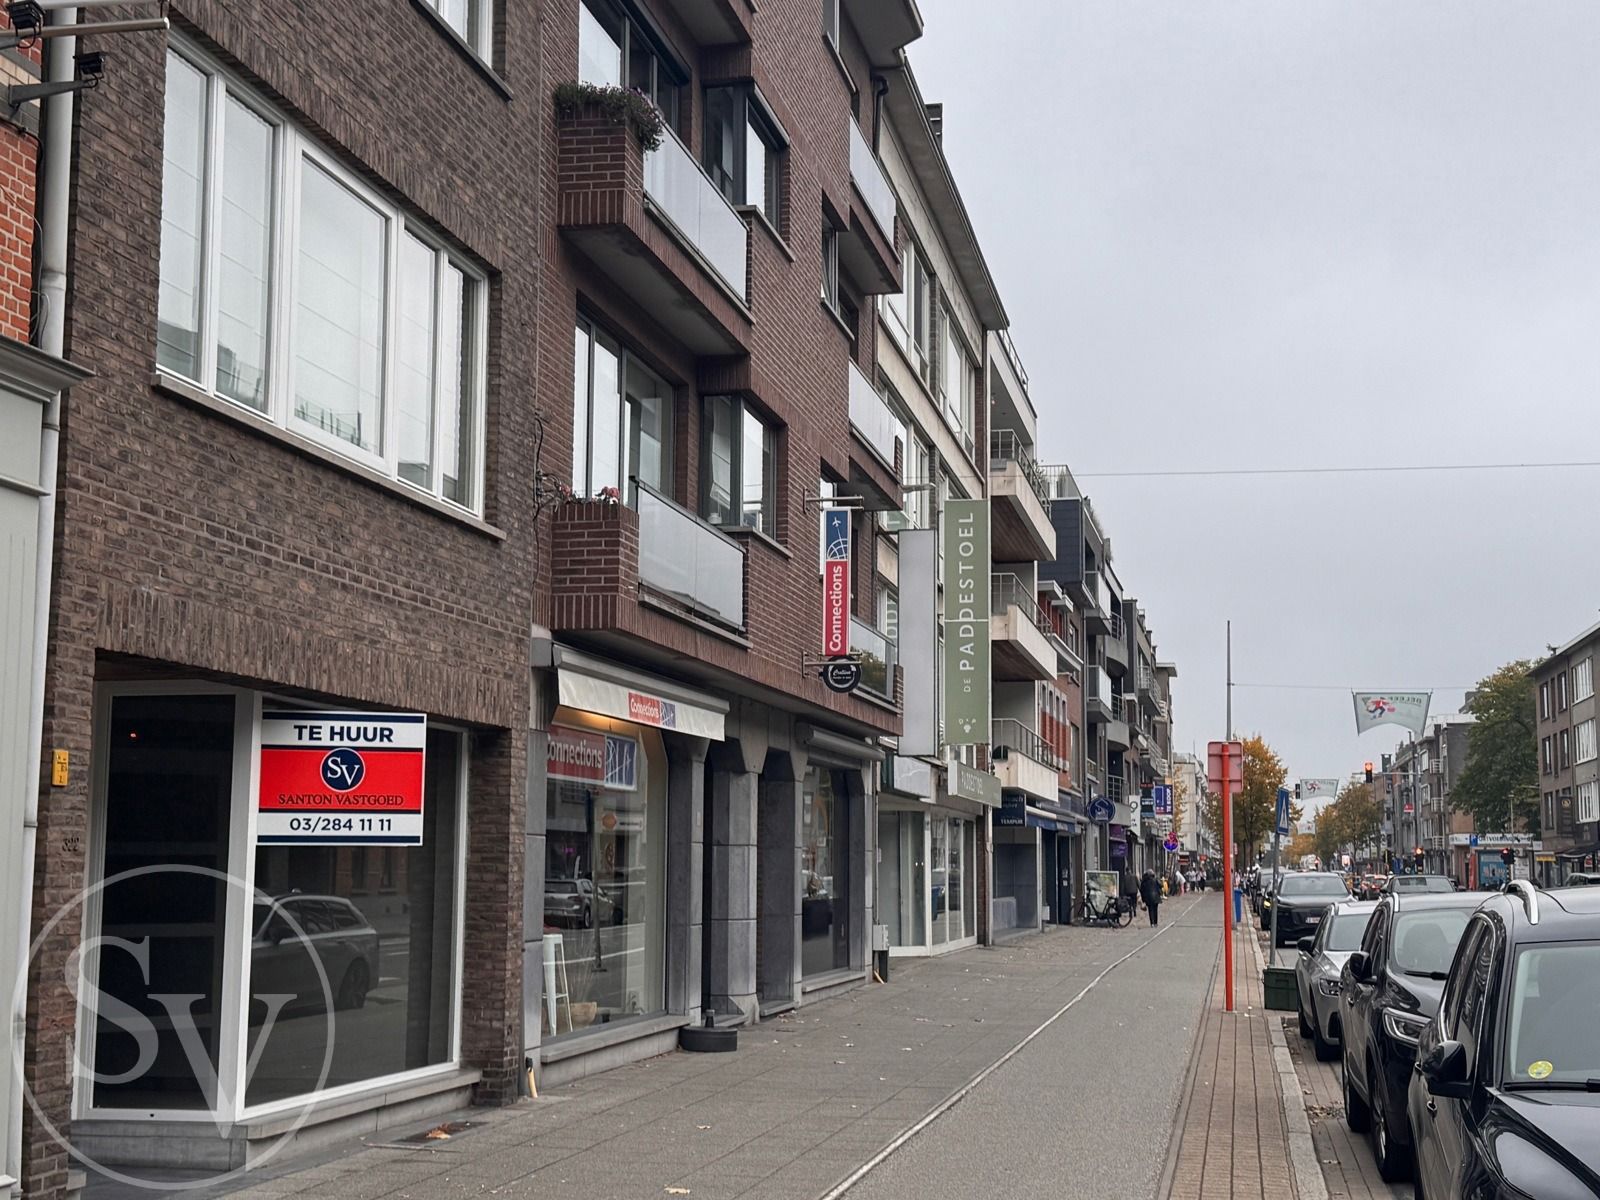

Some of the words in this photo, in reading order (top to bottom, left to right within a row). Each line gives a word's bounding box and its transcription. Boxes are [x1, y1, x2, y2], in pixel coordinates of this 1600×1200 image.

[958, 511, 975, 671] PADDESTOEL
[829, 564, 843, 652] Connections
[963, 678, 972, 693] DE
[630, 697, 660, 719] Connections
[293, 724, 323, 741] TE
[329, 726, 394, 743] HUUR
[327, 756, 361, 787] SV
[278, 793, 332, 806] SANTON
[336, 794, 404, 807] VASTGOED
[289, 816, 353, 833] 03/284
[359, 818, 373, 832] 11
[378, 818, 392, 832] 11
